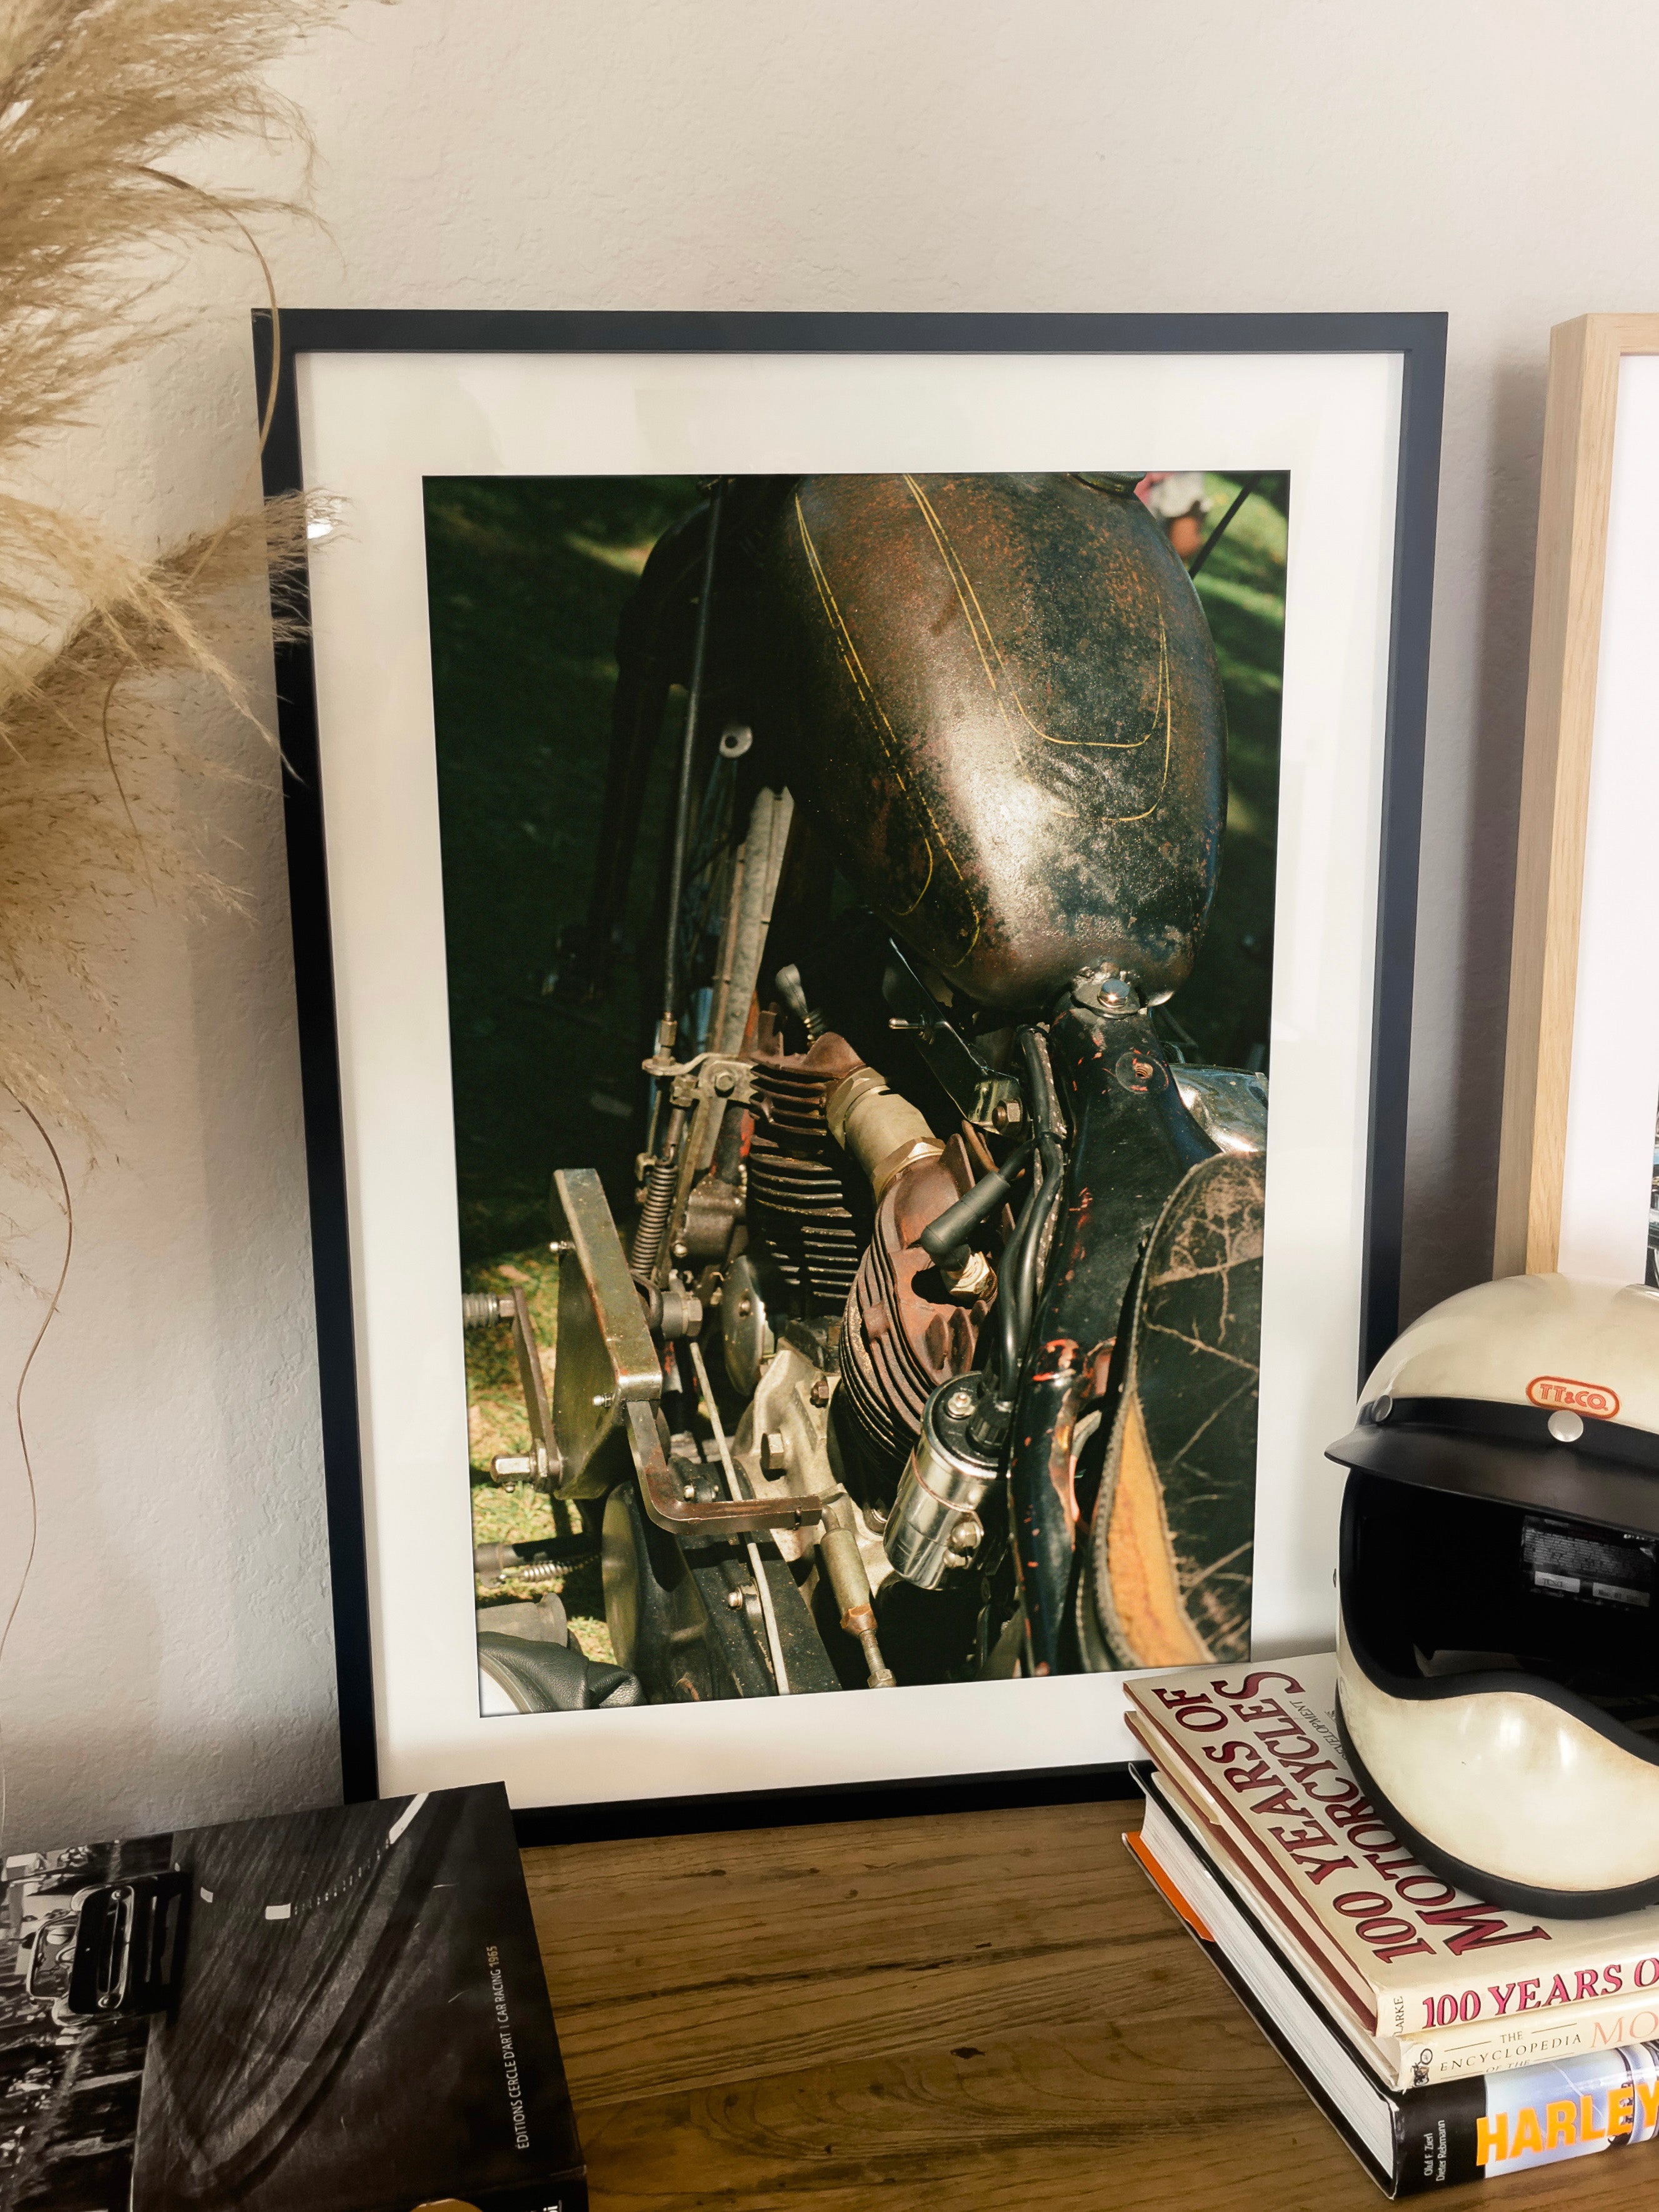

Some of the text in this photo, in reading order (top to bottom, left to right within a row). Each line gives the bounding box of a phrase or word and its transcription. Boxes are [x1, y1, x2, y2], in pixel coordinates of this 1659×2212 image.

[1540, 1383, 1606, 1410] TT&CO
[1150, 1688, 1437, 1964] 100 YEARS OF
[1210, 1671, 1553, 1956] MOTORCYCLES
[486, 1945, 499, 1968] 1965
[490, 1969, 505, 2003] RACING
[1421, 1989, 1481, 2029] 100
[1487, 1964, 1623, 2016] YEARS
[495, 2003, 509, 2023] CAR
[500, 2032, 515, 2059] D'ART
[1440, 2034, 1581, 2072] ENCYCLOPEDIA
[1500, 2031, 1523, 2044] THE
[504, 2060, 521, 2098] CERCLE
[510, 2099, 529, 2149] ÉDITIONS
[1437, 2119, 1447, 2159] Rebmann
[1476, 2079, 1659, 2166] HARLEY
